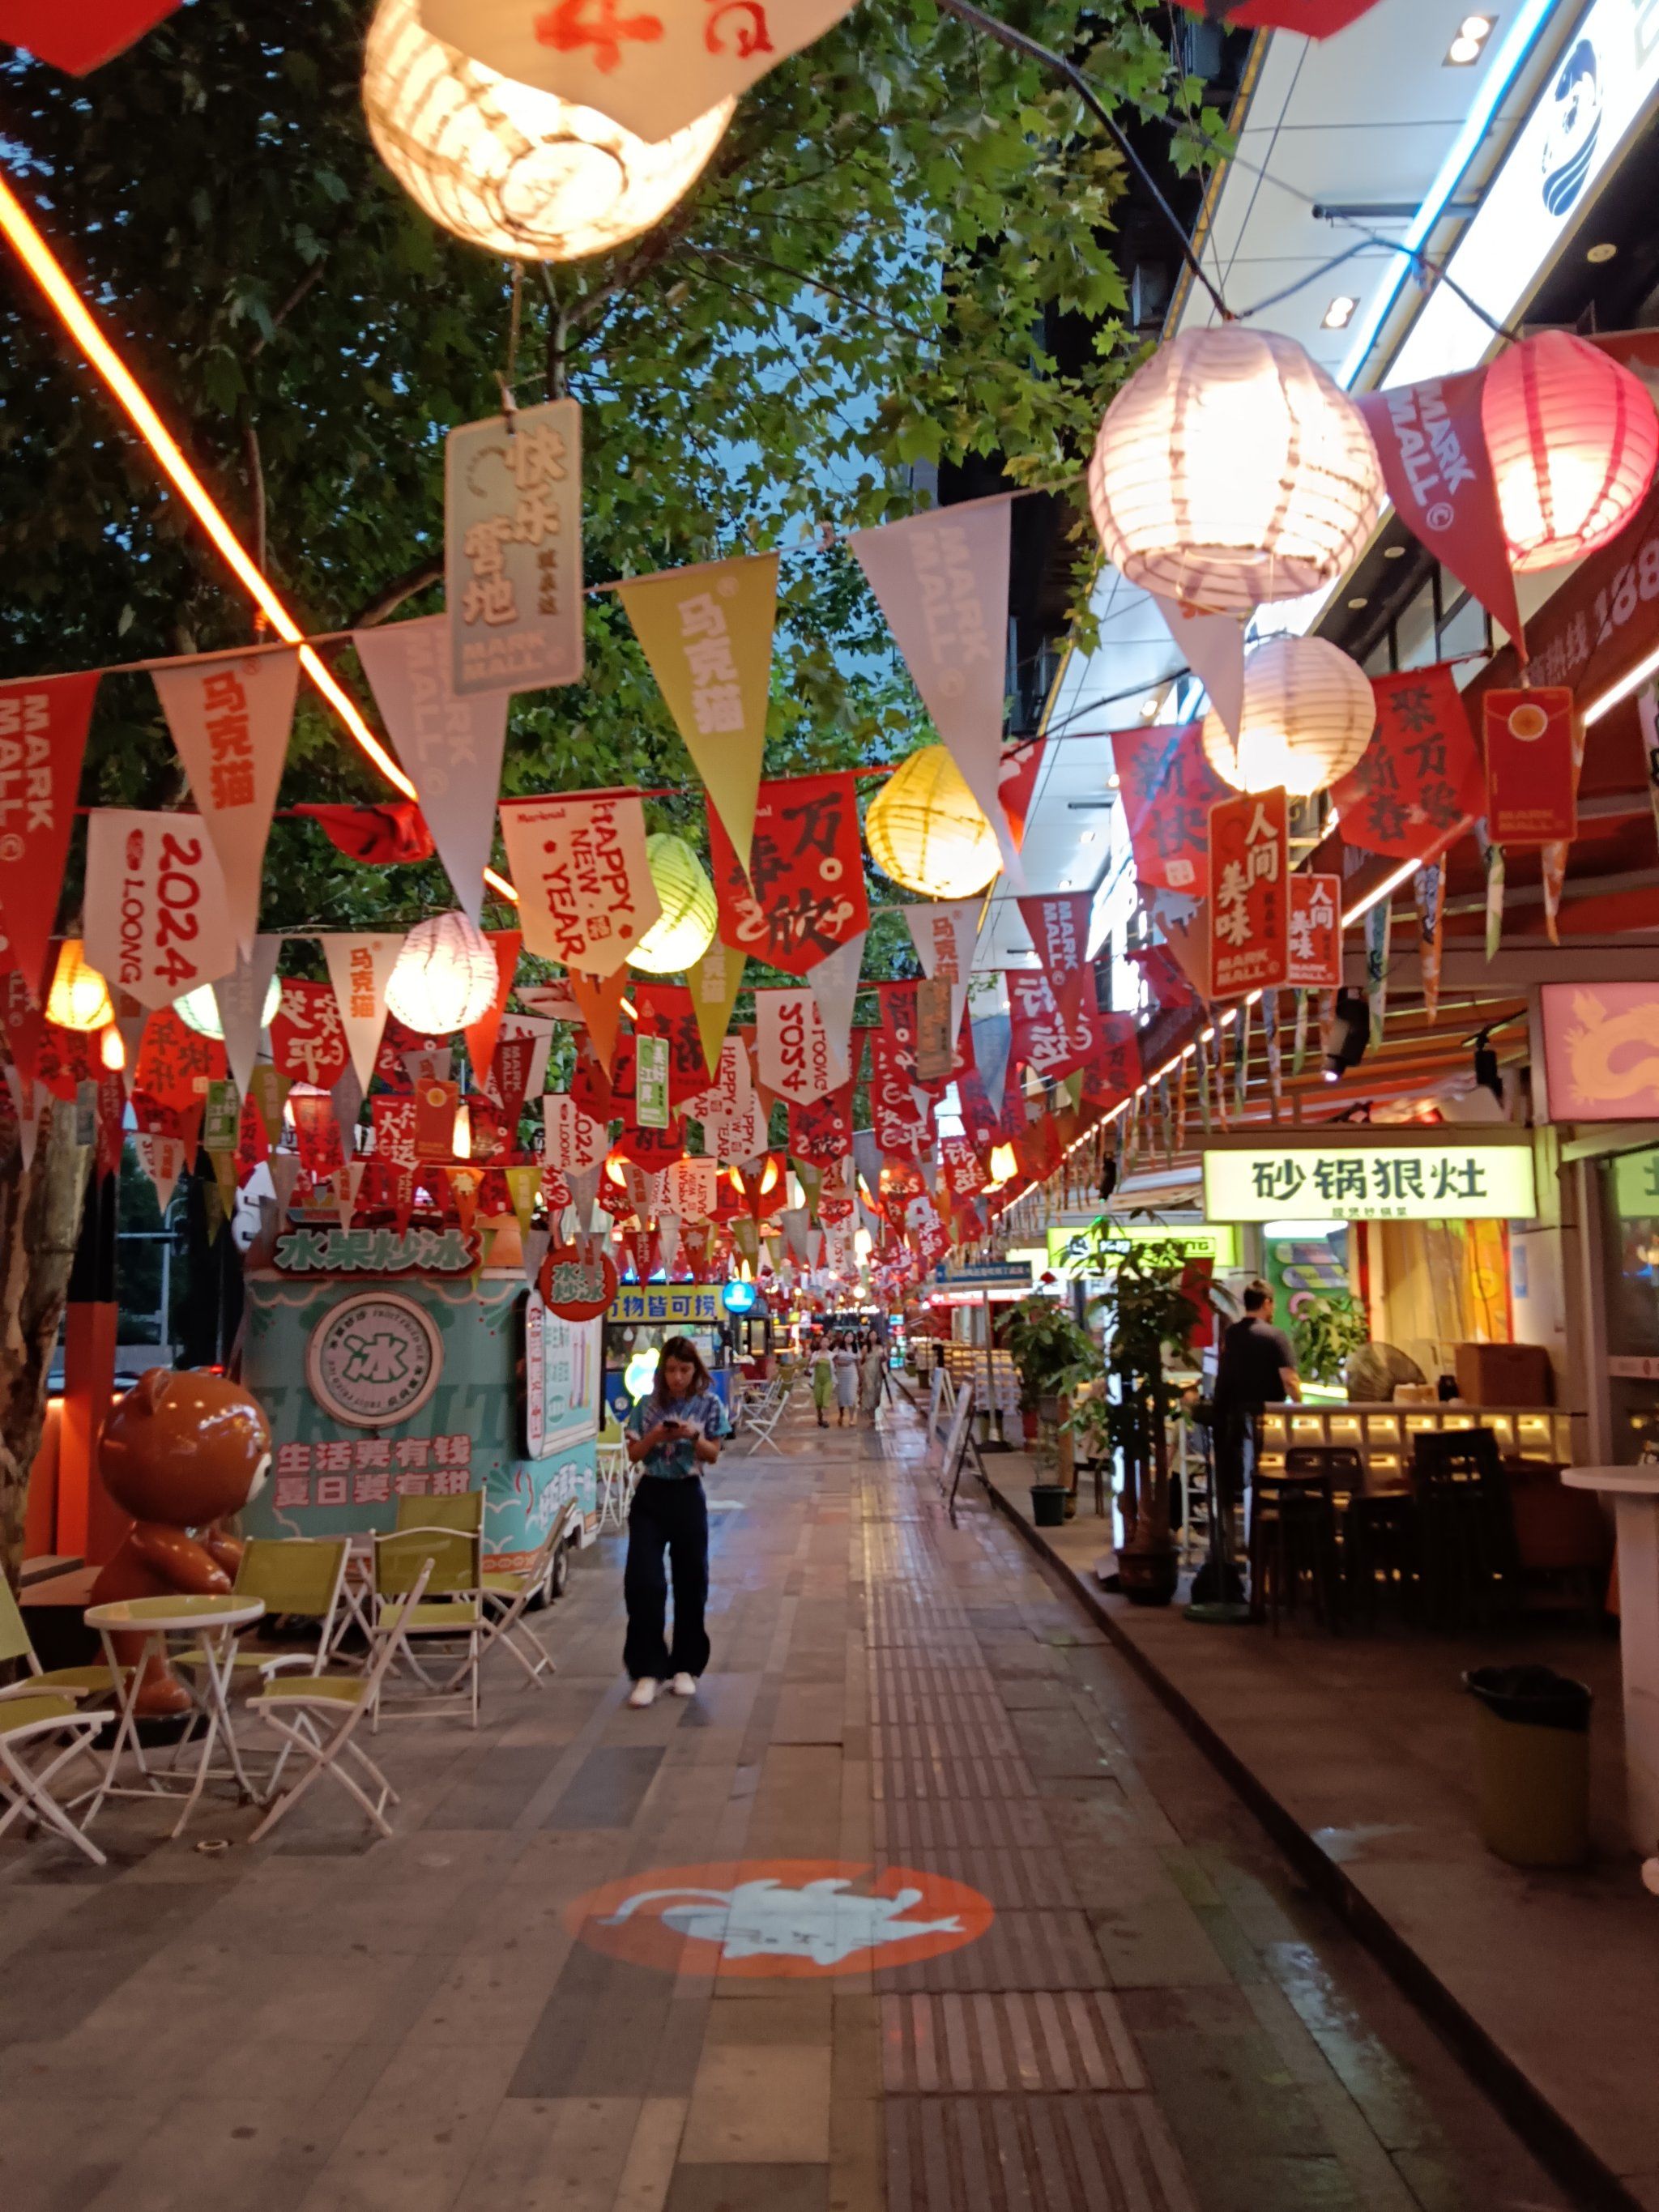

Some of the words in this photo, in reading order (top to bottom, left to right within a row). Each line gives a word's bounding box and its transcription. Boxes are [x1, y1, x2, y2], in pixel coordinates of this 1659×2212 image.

[1384, 388, 1430, 508] MALL
[1416, 380, 1475, 496] MARK
[504, 421, 569, 545] 快乐
[463, 515, 520, 626] 营地
[909, 531, 944, 664] MALL
[939, 526, 991, 663] MARK
[463, 629, 546, 659] MARK
[463, 650, 544, 683] MALL
[678, 593, 745, 734] 马克猫
[23, 693, 54, 833] MARK
[201, 670, 255, 810] 马克猫
[569, 828, 600, 894] NEW
[590, 801, 636, 914] HAPPY
[1245, 802, 1279, 887] 人间
[118, 877, 145, 985] LOONG
[154, 833, 203, 987] 2024
[542, 863, 586, 961] YEAR
[1043, 902, 1060, 967] MALL
[1057, 901, 1080, 970] MARK
[1215, 860, 1253, 947] 美味
[1309, 882, 1334, 931] 人间
[348, 947, 377, 1019] 马克猫
[1217, 948, 1269, 971] MARK
[1217, 964, 1266, 987] MALL
[502, 1046, 513, 1091] MALL
[511, 1046, 522, 1092] MARK
[723, 1046, 736, 1105] HAPPY
[1252, 1157, 1488, 1201] 砂锅狠灶
[273, 1227, 474, 1272] 水果炒冰
[342, 1332, 409, 1383] 冰
[272, 1468, 471, 1508] 夏日要有甜
[276, 1434, 471, 1473] 生活要有钱
